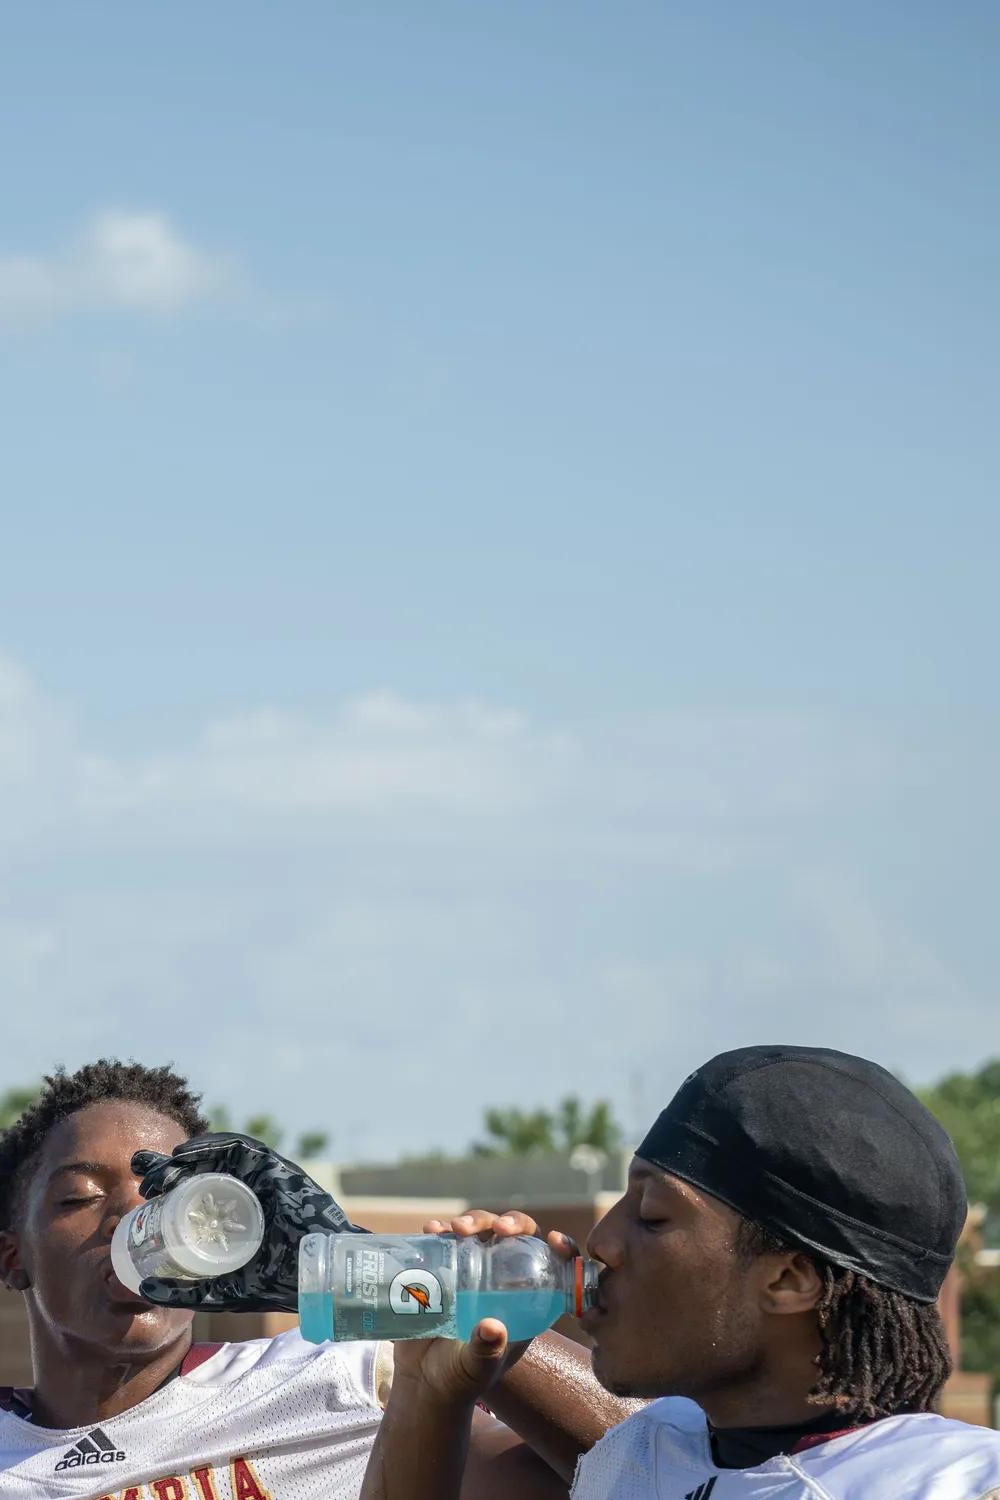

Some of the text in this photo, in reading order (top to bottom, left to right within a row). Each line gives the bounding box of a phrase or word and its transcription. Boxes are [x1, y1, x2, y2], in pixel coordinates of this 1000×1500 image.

[362, 1250, 378, 1309] FROST
[389, 1268, 443, 1315] G
[54, 1450, 127, 1472] adidas
